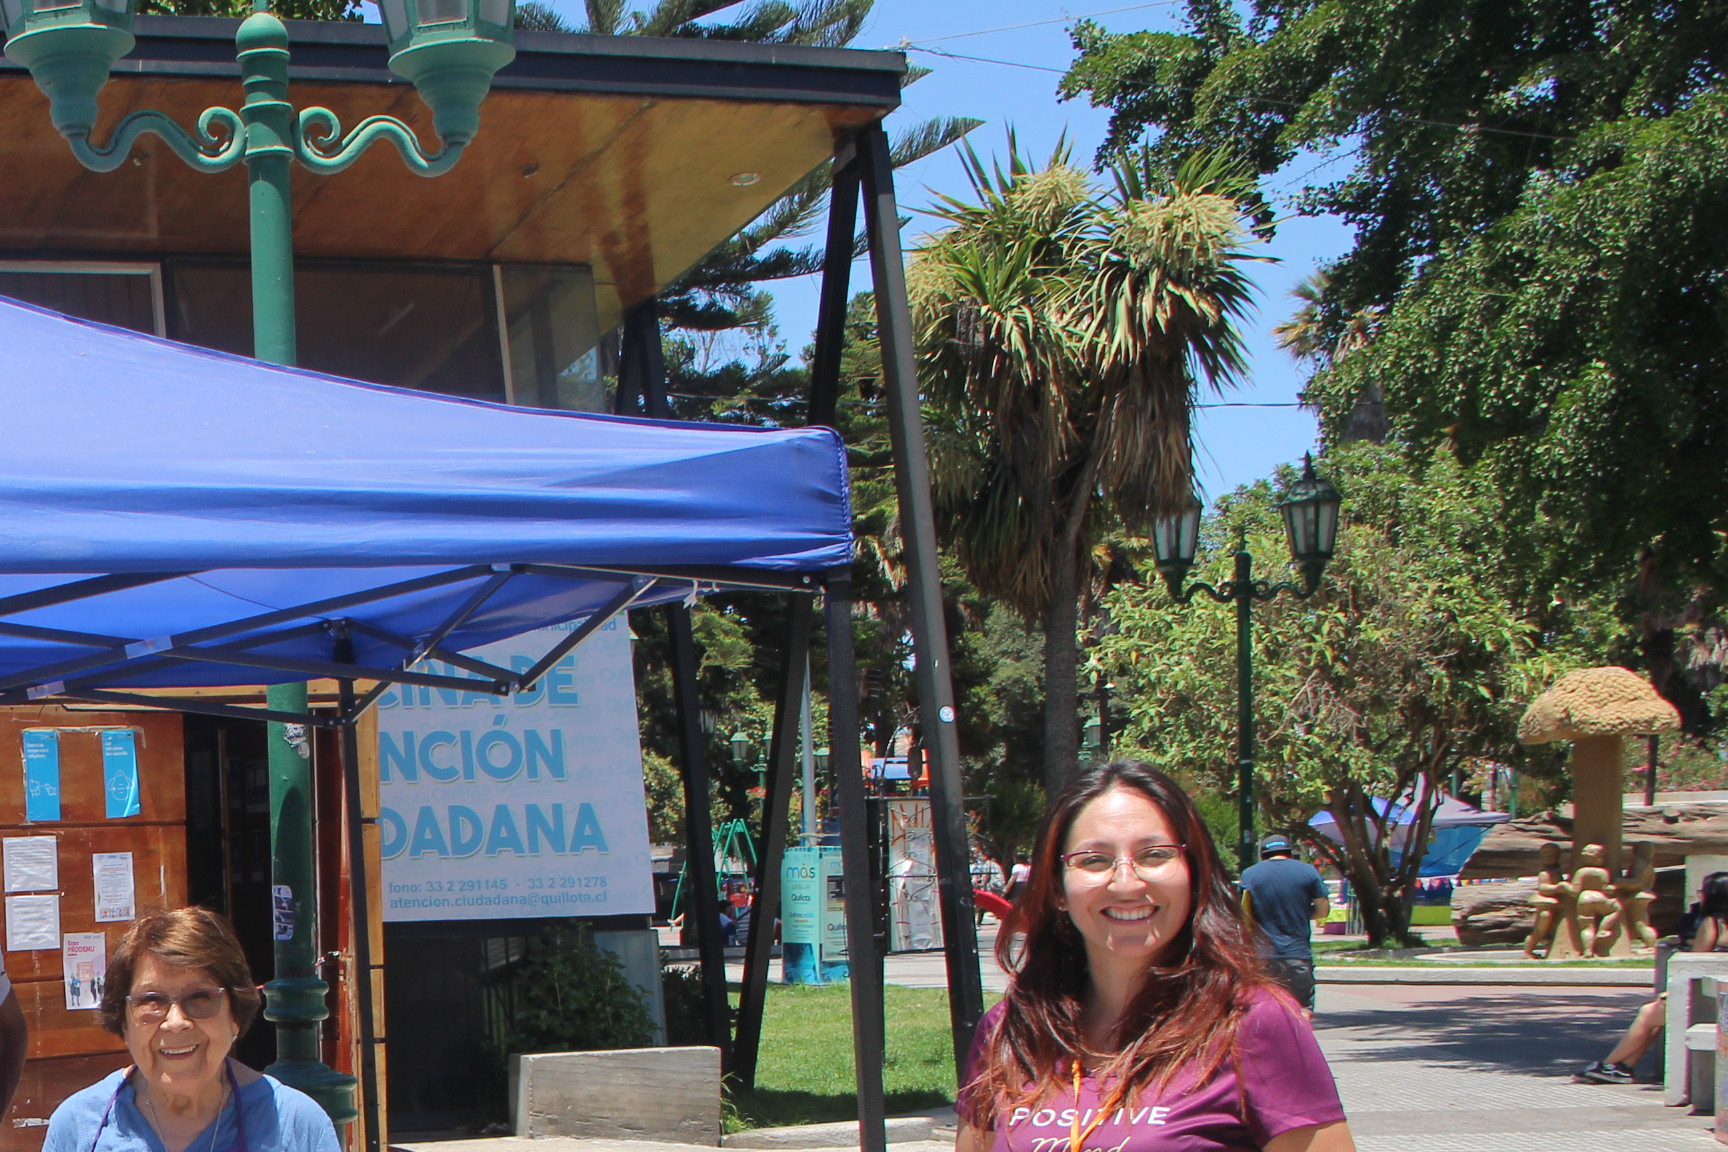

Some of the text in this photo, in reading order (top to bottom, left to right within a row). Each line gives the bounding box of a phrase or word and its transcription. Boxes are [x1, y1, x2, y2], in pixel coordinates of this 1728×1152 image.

[389, 883, 422, 894] fono:
[426, 881, 443, 892] 33
[446, 881, 454, 891] 2
[528, 878, 545, 889] 33
[548, 878, 556, 888] 2
[560, 877, 607, 889] 291278
[390, 891, 607, 909] atencion.ciudadana@quillota.cl
